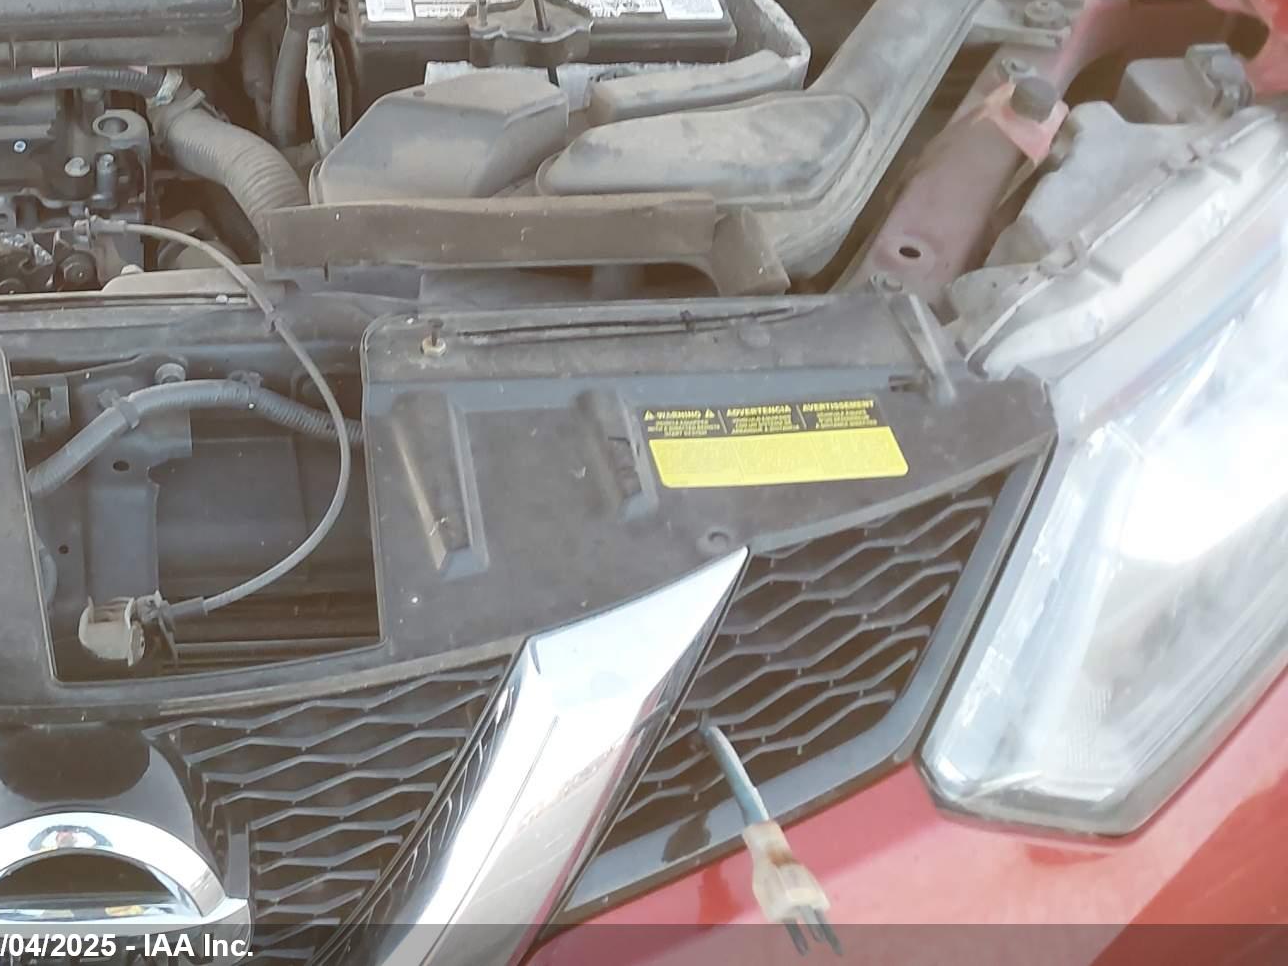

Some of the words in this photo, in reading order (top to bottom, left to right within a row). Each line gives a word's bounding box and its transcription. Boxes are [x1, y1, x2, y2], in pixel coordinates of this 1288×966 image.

[726, 404, 792, 417] ADVERTENCIA
[802, 399, 874, 412] AVERTISSEMENT
[656, 410, 702, 419] WARNING
